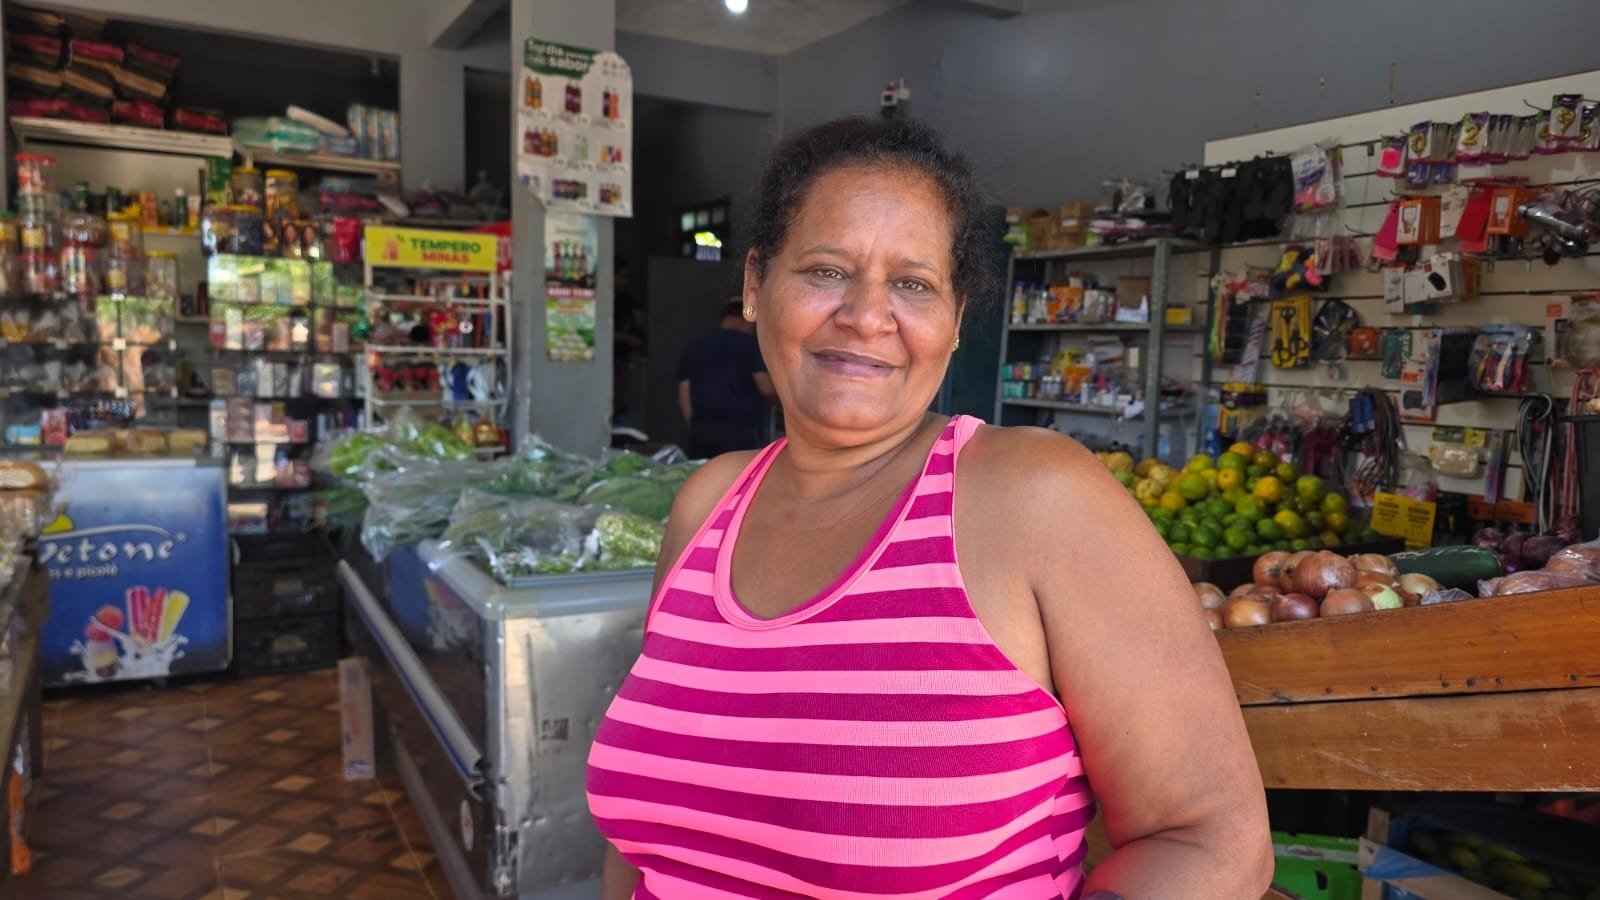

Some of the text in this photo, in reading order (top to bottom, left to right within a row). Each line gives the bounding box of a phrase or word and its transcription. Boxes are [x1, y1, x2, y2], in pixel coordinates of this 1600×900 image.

[549, 56, 587, 72] sabor
[411, 237, 481, 254] TEMPERO
[422, 251, 469, 264] MINAS
[39, 537, 174, 565] etone
